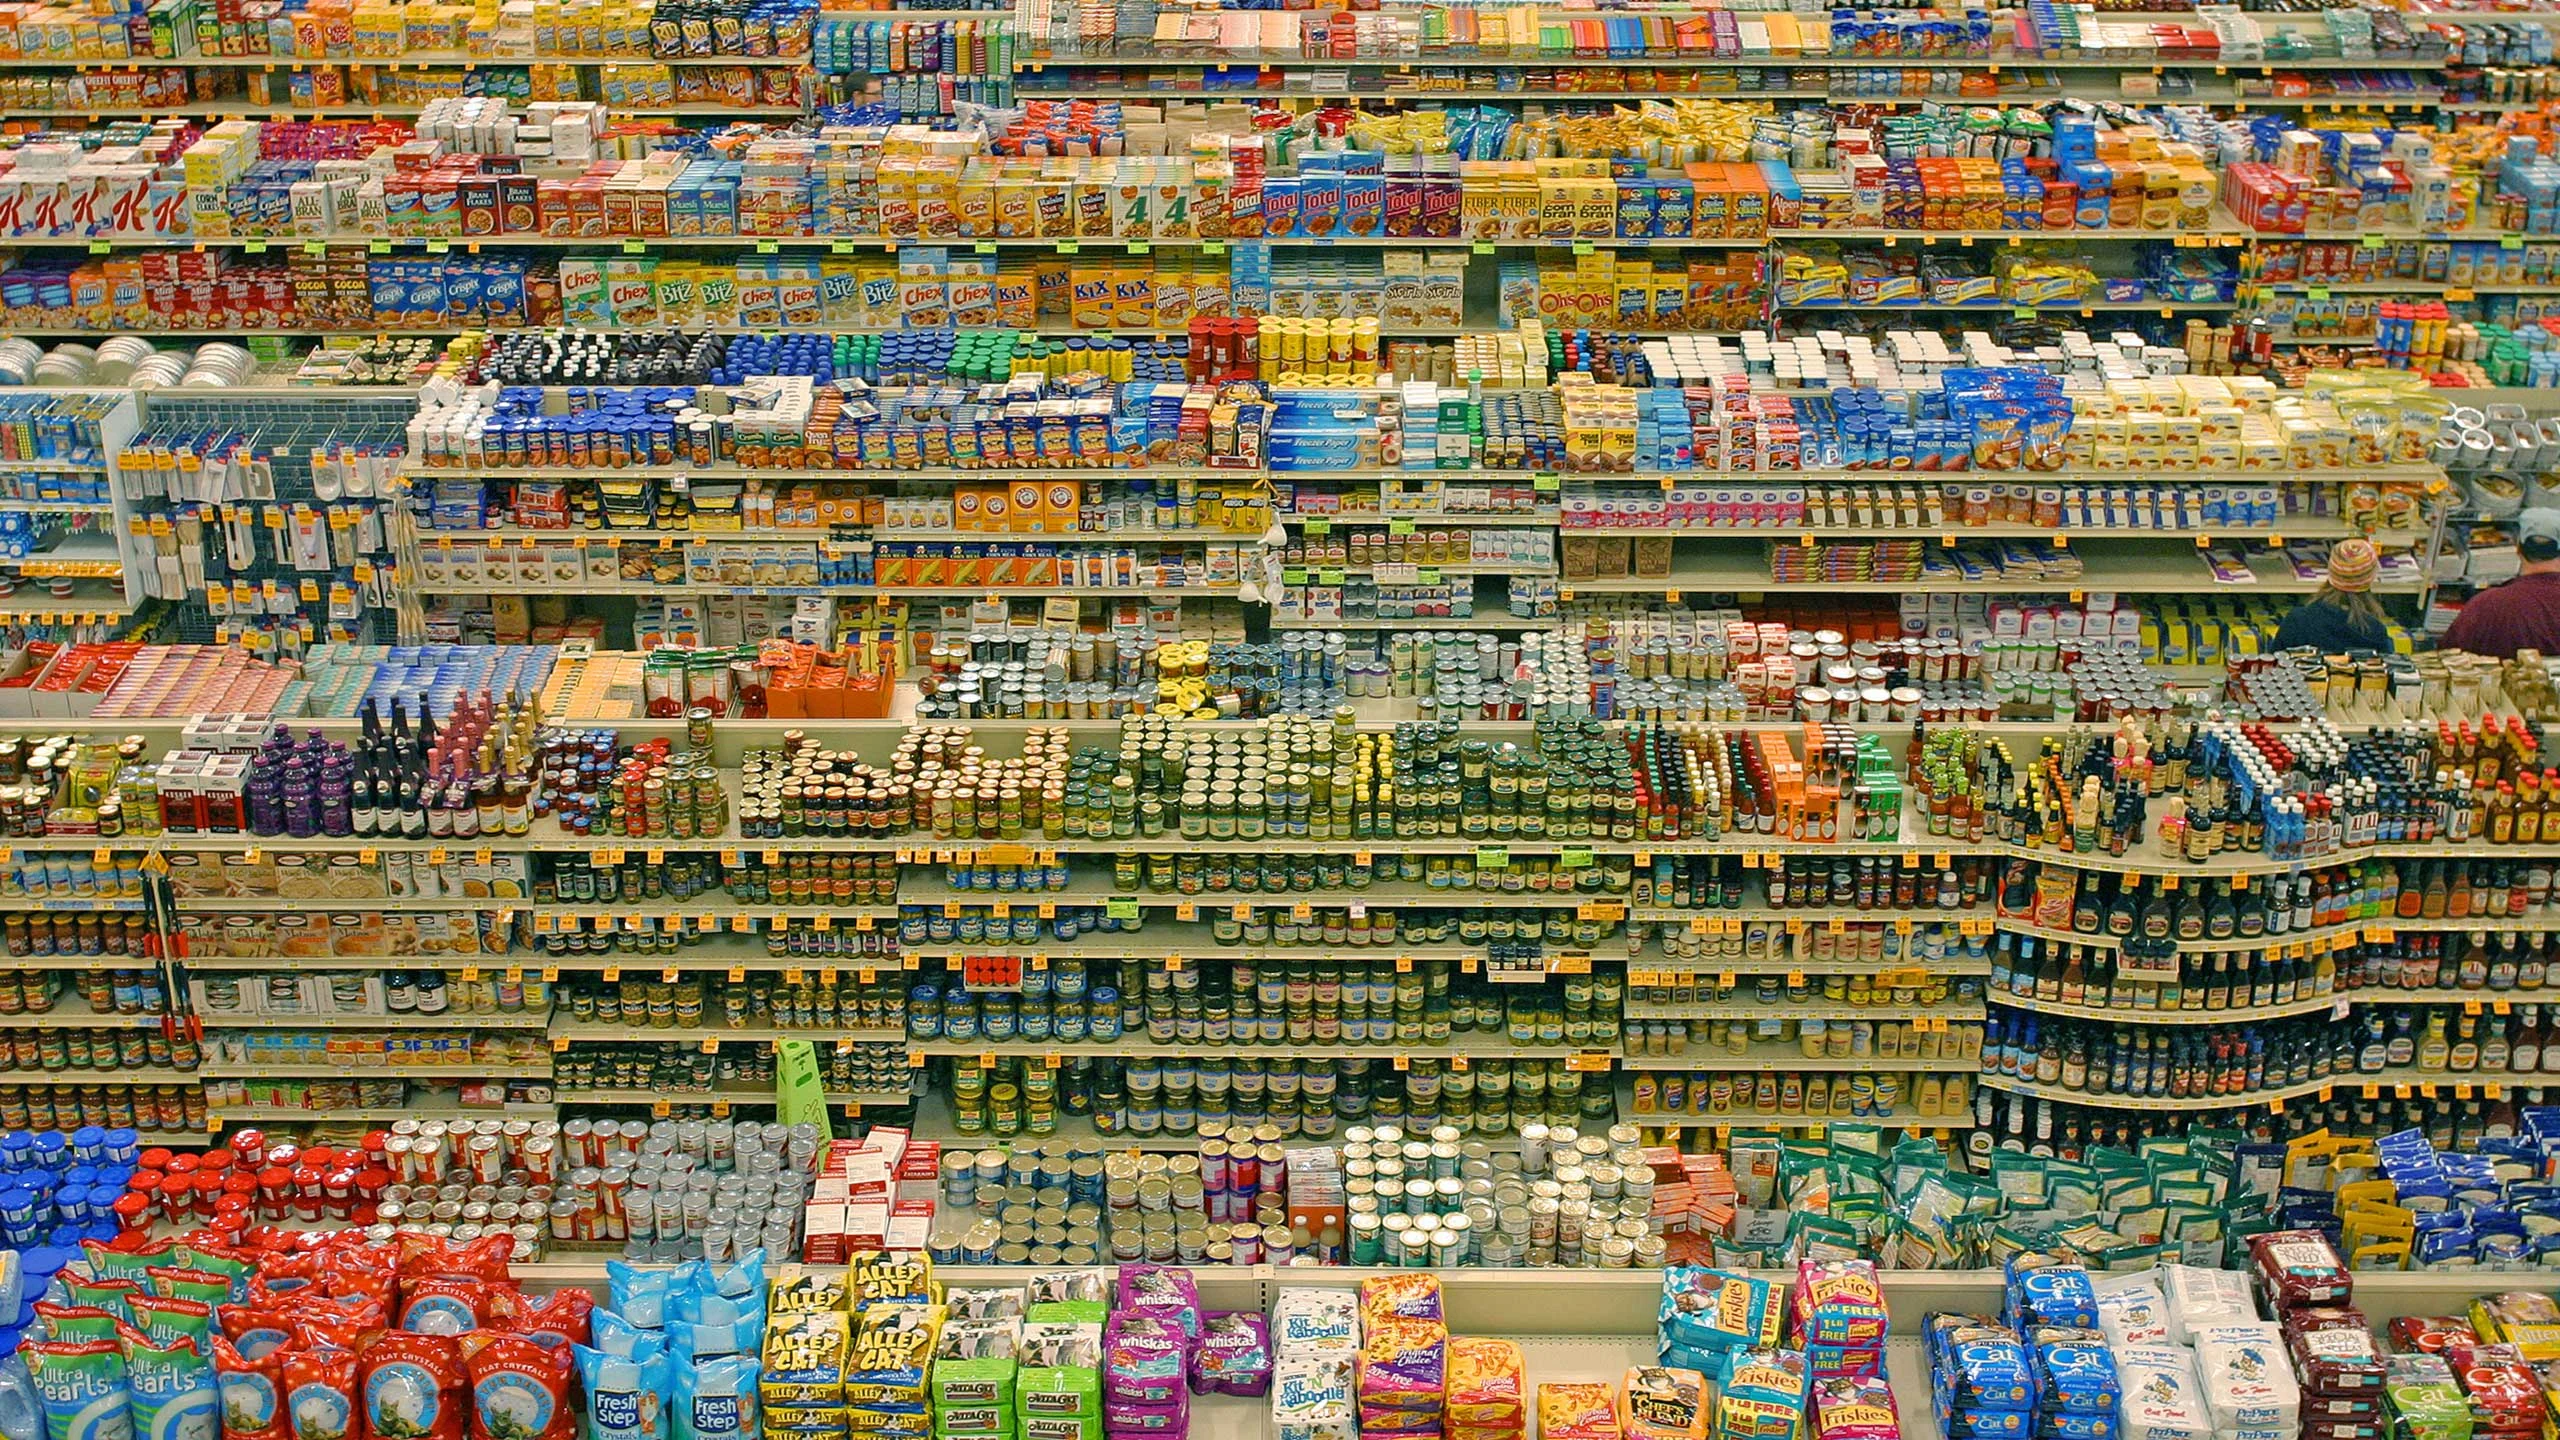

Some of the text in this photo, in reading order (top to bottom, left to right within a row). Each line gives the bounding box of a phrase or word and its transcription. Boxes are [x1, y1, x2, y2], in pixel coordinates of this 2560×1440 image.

[1420, 79, 1465, 91] GIANT
[195, 194, 219, 203] CORN
[469, 191, 489, 200] BRAN
[507, 194, 533, 203] FLAKES
[508, 187, 530, 196] BRAN
[1304, 188, 1340, 210] Total
[1346, 186, 1381, 209] Total
[113, 178, 149, 231] K
[466, 197, 493, 207] FLAKES
[964, 202, 987, 214] Chex
[1003, 202, 1028, 214] Chex
[1231, 193, 1261, 209] Total
[1264, 193, 1298, 211] Total
[1387, 190, 1422, 210] Total
[1426, 190, 1461, 210] Total
[1464, 197, 1498, 208] FIBER
[1503, 197, 1537, 208] FIBER
[1545, 204, 1573, 212] corn
[1583, 204, 1612, 212] corn
[1772, 194, 1800, 212] Alpen
[152, 186, 188, 232] K
[295, 206, 322, 216] BRAN
[882, 203, 911, 218] Chex
[921, 203, 949, 217] Chex
[1125, 196, 1148, 223] 4
[1165, 196, 1188, 223] 4
[1464, 207, 1490, 217] ONE
[1502, 207, 1529, 217] ONE
[1543, 210, 1577, 219] bran
[1580, 210, 1614, 219] bran
[296, 280, 326, 290] COCOA
[334, 280, 365, 290] COCOA
[449, 279, 481, 296] Crispix
[487, 278, 518, 295] Crispix
[565, 272, 600, 290] Chex
[613, 285, 649, 303] Chex
[658, 282, 695, 304] Bitz
[700, 282, 737, 304] Bitz
[743, 287, 775, 306] Chex
[783, 287, 816, 305] Chex
[862, 280, 899, 302] Bitz
[905, 285, 943, 305] Chex
[952, 283, 990, 303] Chex
[1386, 285, 1422, 299] Swirls
[1425, 285, 1461, 299] Swirls
[805, 431, 828, 439] Oven
[1294, 438, 1351, 448] Freezer Paper
[1294, 456, 1351, 466] Freezer Paper
[2276, 1243, 2319, 1256] SPECIAL
[107, 1265, 146, 1280] Ultra
[857, 1265, 922, 1285] ALLEY
[863, 1280, 915, 1299] CAT
[1816, 1279, 1874, 1300] Friskies
[2026, 1273, 2080, 1292] Cat
[776, 1291, 843, 1312] ALLEY
[1134, 1294, 1188, 1307] whiskas
[1394, 1296, 1438, 1311] Original
[1725, 1281, 1744, 1332] Friskies
[1768, 1286, 1781, 1317] FREE
[1842, 1307, 1882, 1316] FREE
[1286, 1323, 1350, 1339] Kaboodle
[1287, 1317, 1310, 1331] Kit
[856, 1330, 928, 1349] ALLEY
[1118, 1336, 1174, 1350] whiskas
[1204, 1333, 1257, 1348] whiskas
[1818, 1330, 1846, 1341] FREE
[2308, 1331, 2361, 1345] SPECIAL
[2417, 1331, 2475, 1350] Cat
[766, 1336, 839, 1353] ALLEY
[774, 1350, 824, 1371] CAT
[860, 1349, 913, 1371] CAT
[1394, 1347, 1440, 1360] Original
[1962, 1345, 2014, 1364] Cat
[2048, 1347, 2102, 1368] Cat
[133, 1358, 172, 1378] Ultra
[375, 1350, 445, 1376] FLAT CRYSTALS
[477, 1361, 549, 1379] FLAT CRYSTALS
[1395, 1357, 1433, 1368] Choice
[1814, 1360, 1840, 1369] FREE
[43, 1366, 84, 1384] Ultra
[127, 1364, 197, 1392] Pearls
[1368, 1365, 1414, 1388] 20% Free
[1479, 1377, 1516, 1389] Hairball
[2465, 1367, 2521, 1388] Cat
[33, 1375, 111, 1402] Pearls
[1114, 1386, 1145, 1398] whiskas
[1282, 1380, 1305, 1395] Kit
[1483, 1384, 1516, 1394] Control
[1983, 1388, 2009, 1401] Cat
[2394, 1386, 2450, 1404] Cat
[595, 1393, 637, 1412] Fresh
[1279, 1387, 1347, 1408] Kaboodle
[2070, 1395, 2094, 1408] Cat
[695, 1396, 738, 1416] Fresh
[1637, 1399, 1685, 1415] CHEF'S
[1737, 1400, 1752, 1409] LB
[1754, 1403, 1794, 1418] FREE
[598, 1408, 636, 1428] Step
[696, 1412, 737, 1432] Step
[1112, 1414, 1143, 1425] whiskas
[1575, 1409, 1610, 1423] Hairball
[1579, 1413, 1613, 1427] Control
[1637, 1408, 1690, 1428] BLEND
[1824, 1410, 1890, 1429] Friskies
[2490, 1414, 2520, 1428] Cat
[1728, 1423, 1755, 1436] FREE
[1978, 1418, 2003, 1431] Cat
[2066, 1423, 2091, 1436] Cat
